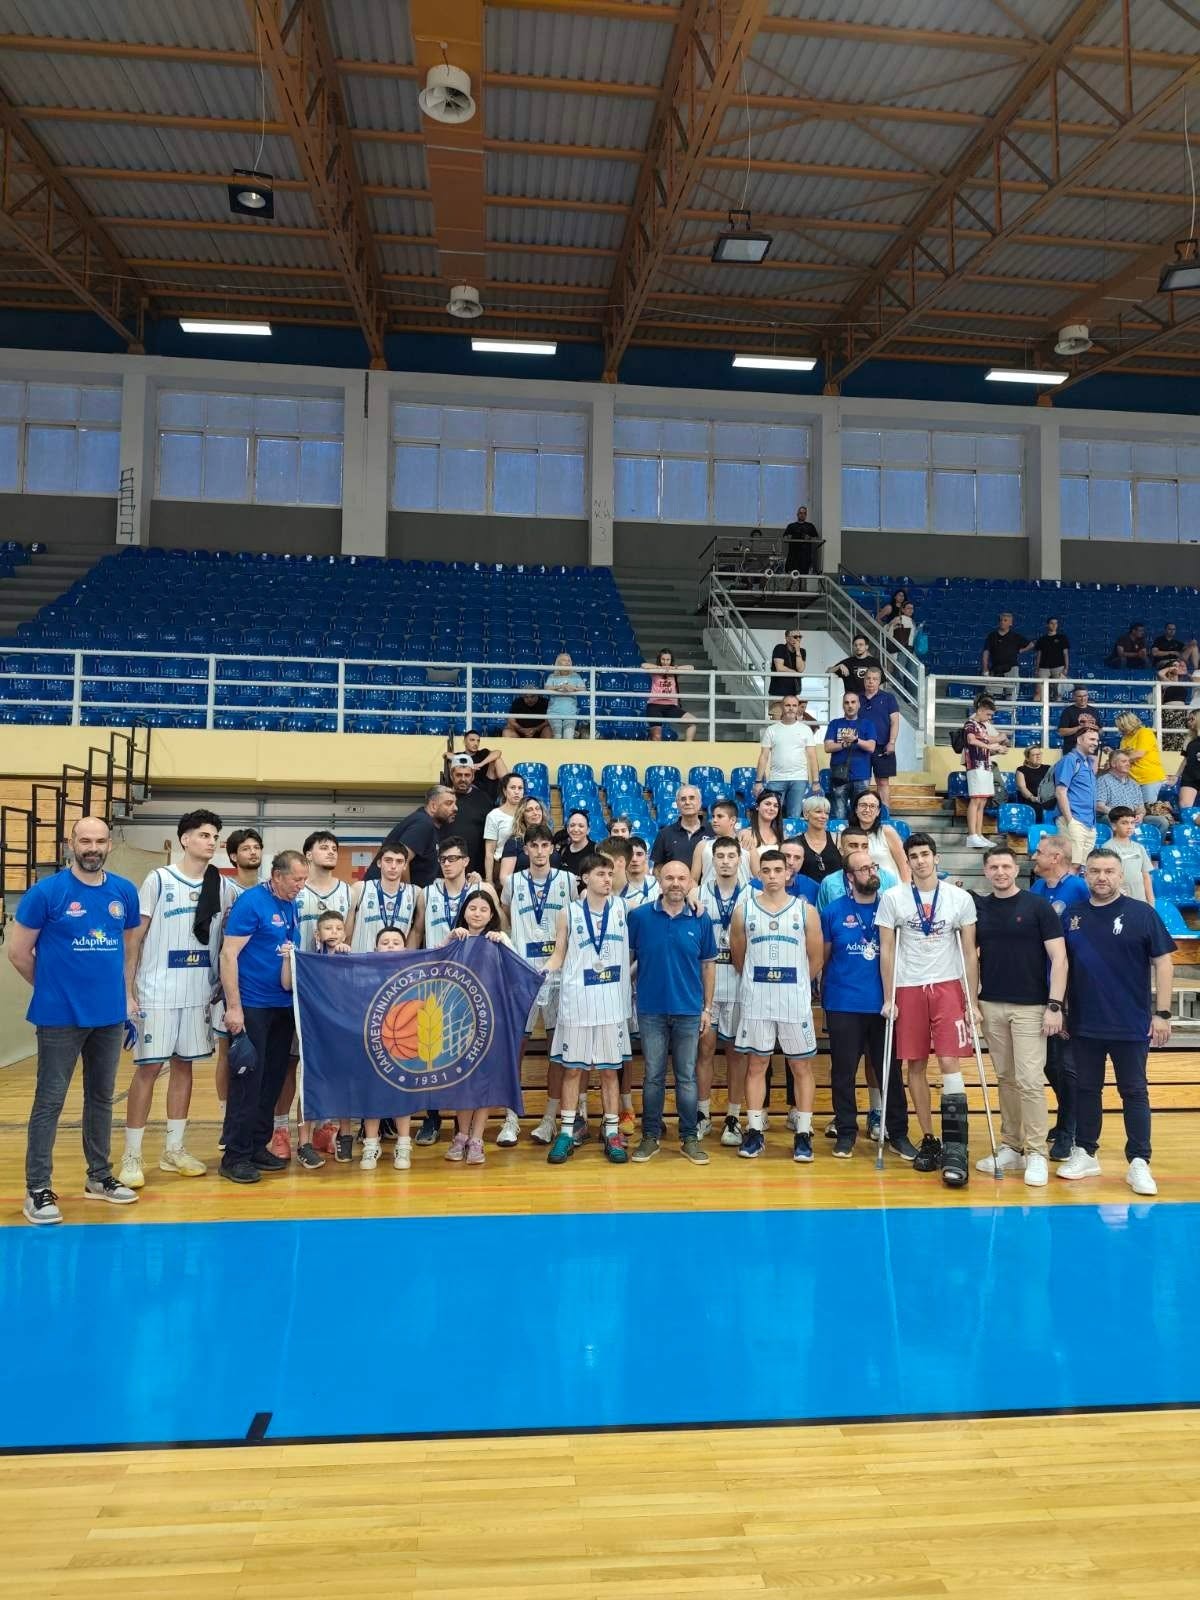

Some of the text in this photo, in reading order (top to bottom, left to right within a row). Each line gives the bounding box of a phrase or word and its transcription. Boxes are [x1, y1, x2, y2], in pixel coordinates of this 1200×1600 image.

[541, 944, 555, 954] 4U
[186, 953, 200, 963] 4U
[599, 970, 612, 980] 4U
[767, 970, 781, 979] 4U
[370, 972, 416, 1074] ΠΑΝΕΛΕΥΣΙΝΙΑΚΟΣ
[444, 966, 488, 1063] ΚΑΛΑΘΟΣΦΑΙΡΙΣΗΣ
[414, 1071, 447, 1086] 1931
